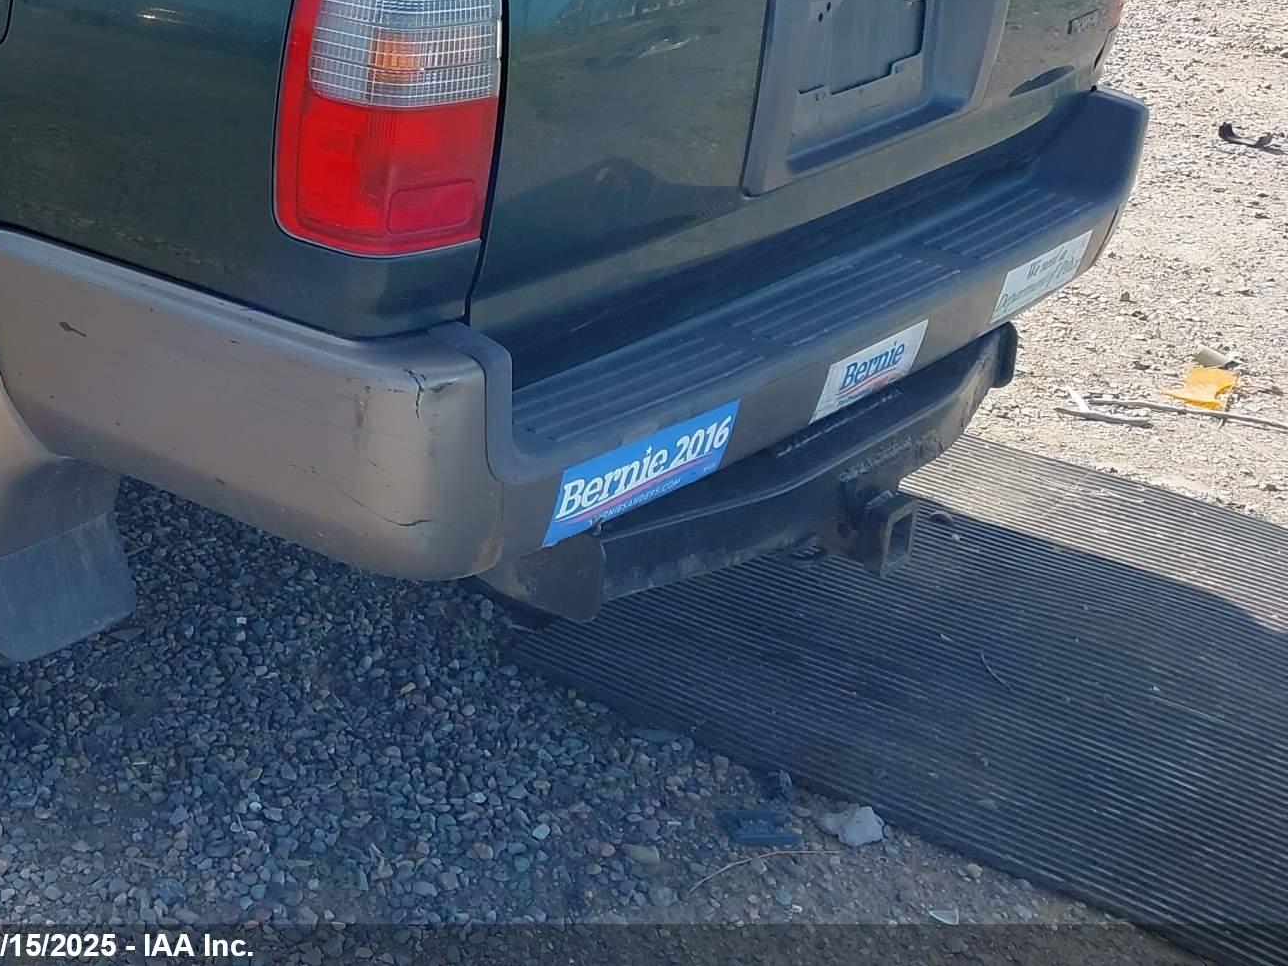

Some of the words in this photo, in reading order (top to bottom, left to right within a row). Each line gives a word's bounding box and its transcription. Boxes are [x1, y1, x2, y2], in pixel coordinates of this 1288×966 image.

[839, 341, 905, 391] Bernie
[555, 445, 669, 519] Bernie
[668, 415, 732, 468] 2016
[589, 477, 682, 525] RNIESANDERS.COM
